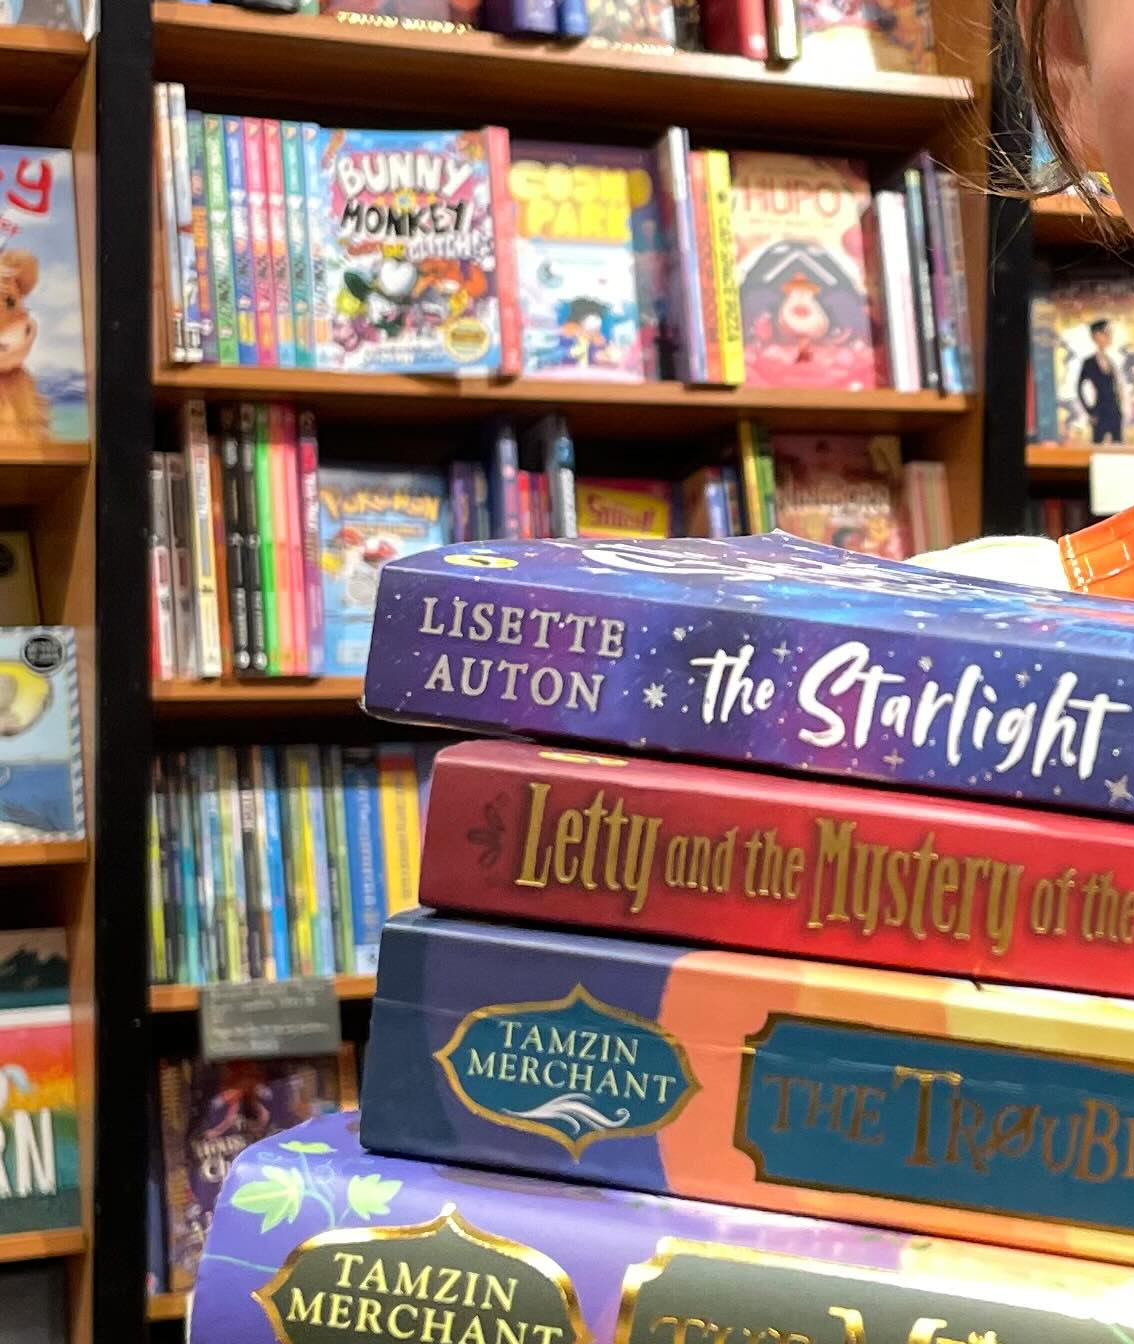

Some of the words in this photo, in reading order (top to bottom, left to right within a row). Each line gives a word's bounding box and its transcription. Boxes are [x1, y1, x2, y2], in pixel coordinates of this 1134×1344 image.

[337, 152, 474, 199] BUNNY
[339, 198, 474, 238] MONKEY
[419, 596, 625, 658] LISETTE
[424, 654, 606, 713] AUTON
[798, 641, 1132, 779] Starlight
[514, 781, 664, 914] Letty
[665, 824, 740, 893] and
[745, 829, 805, 900] the
[805, 816, 1025, 955] Mystery
[1031, 867, 1078, 936] of
[499, 1019, 641, 1065] TAMZIN
[466, 1047, 677, 1104] MERCHANT
[762, 1074, 888, 1146] THE
[332, 1251, 520, 1312] TAMZIN
